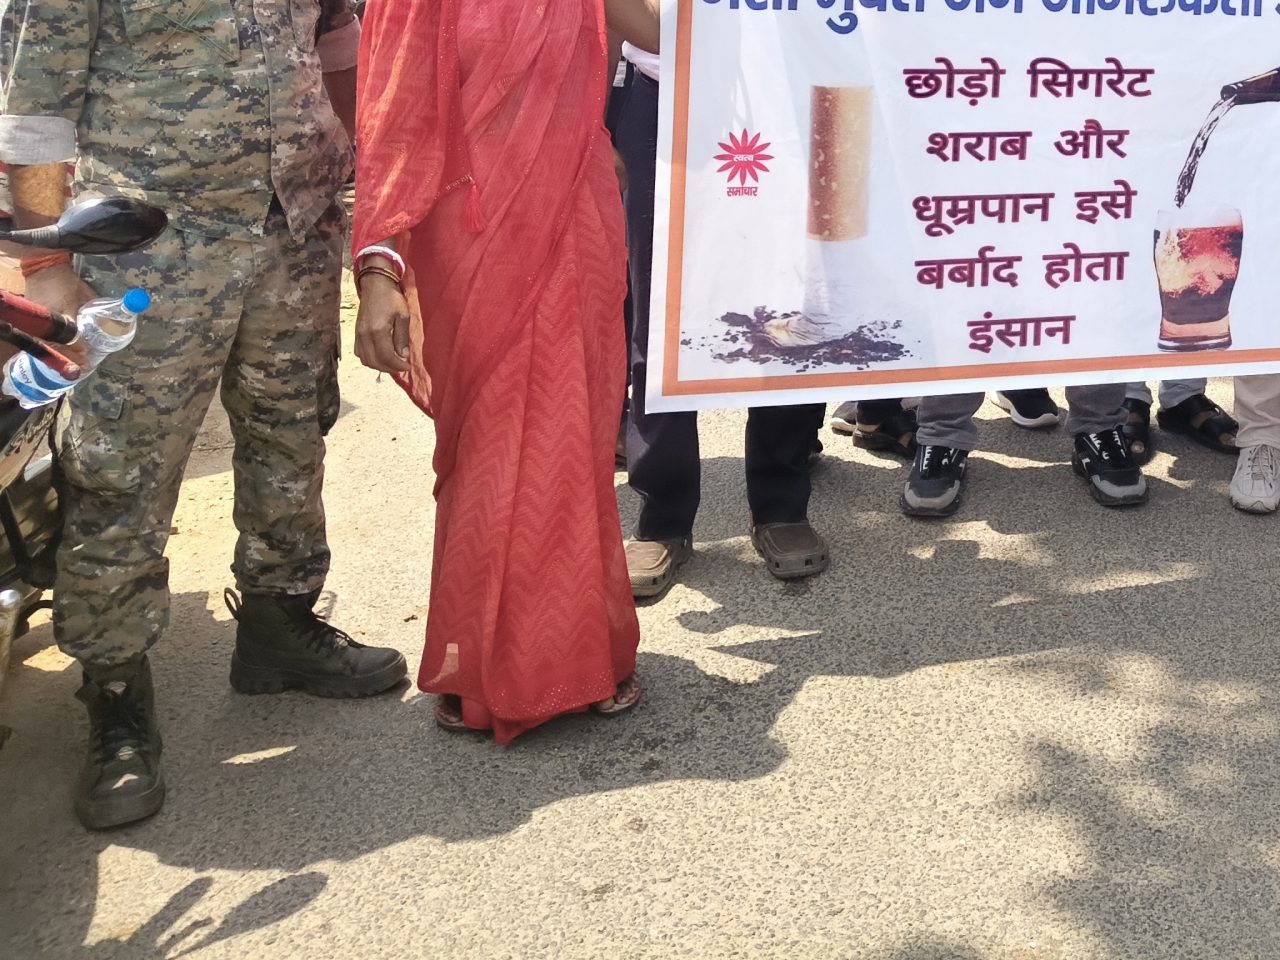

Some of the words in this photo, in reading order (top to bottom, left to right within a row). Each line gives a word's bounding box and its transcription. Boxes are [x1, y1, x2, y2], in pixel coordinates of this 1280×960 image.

[903, 57, 1006, 106] छोड़ो
[1027, 57, 1155, 98] सिगरेट
[926, 131, 1033, 162] शराब
[1054, 119, 1130, 159] और
[912, 192, 1055, 237] धूम्रपान
[1074, 180, 1138, 224] इसे
[914, 245, 1023, 290] बर्बाद
[1042, 242, 1130, 289] होता
[967, 311, 1077, 353] इंसान
